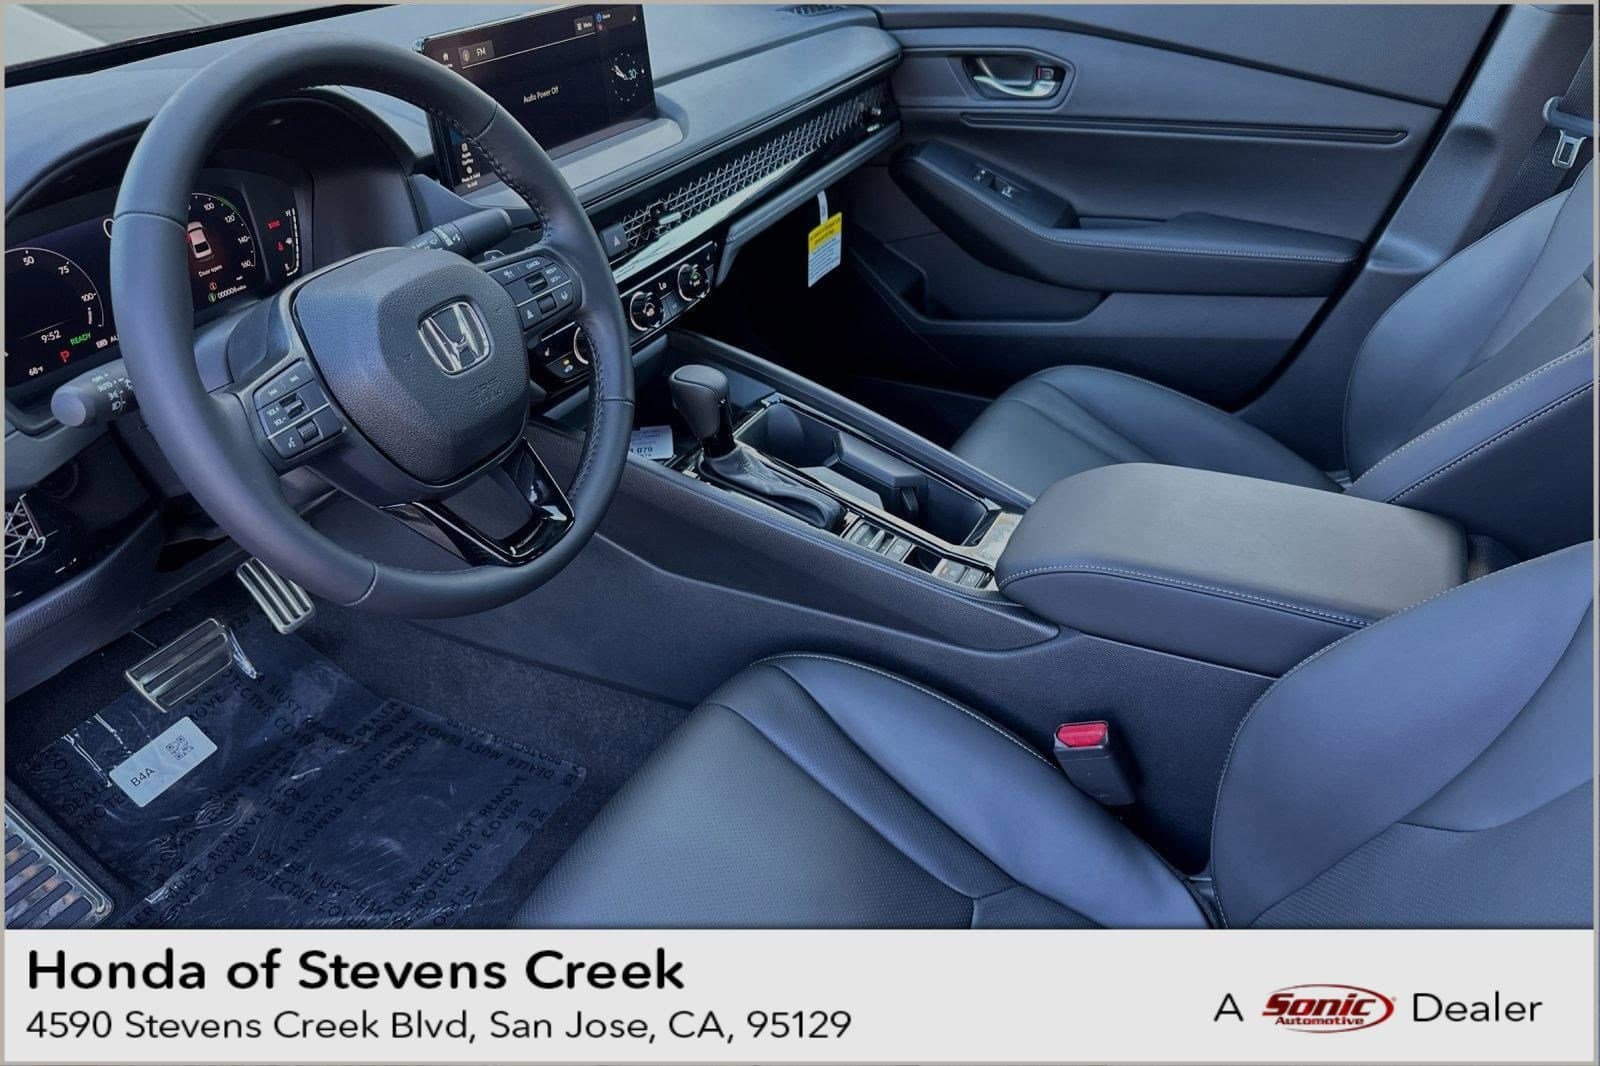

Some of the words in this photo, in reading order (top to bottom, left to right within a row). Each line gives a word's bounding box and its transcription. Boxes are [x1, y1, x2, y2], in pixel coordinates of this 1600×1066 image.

[23, 256, 35, 266] 50
[58, 265, 70, 275] 75
[81, 293, 94, 302] 100
[41, 330, 62, 343] 9:52
[70, 331, 91, 346] READY
[130, 767, 155, 787] B4A
